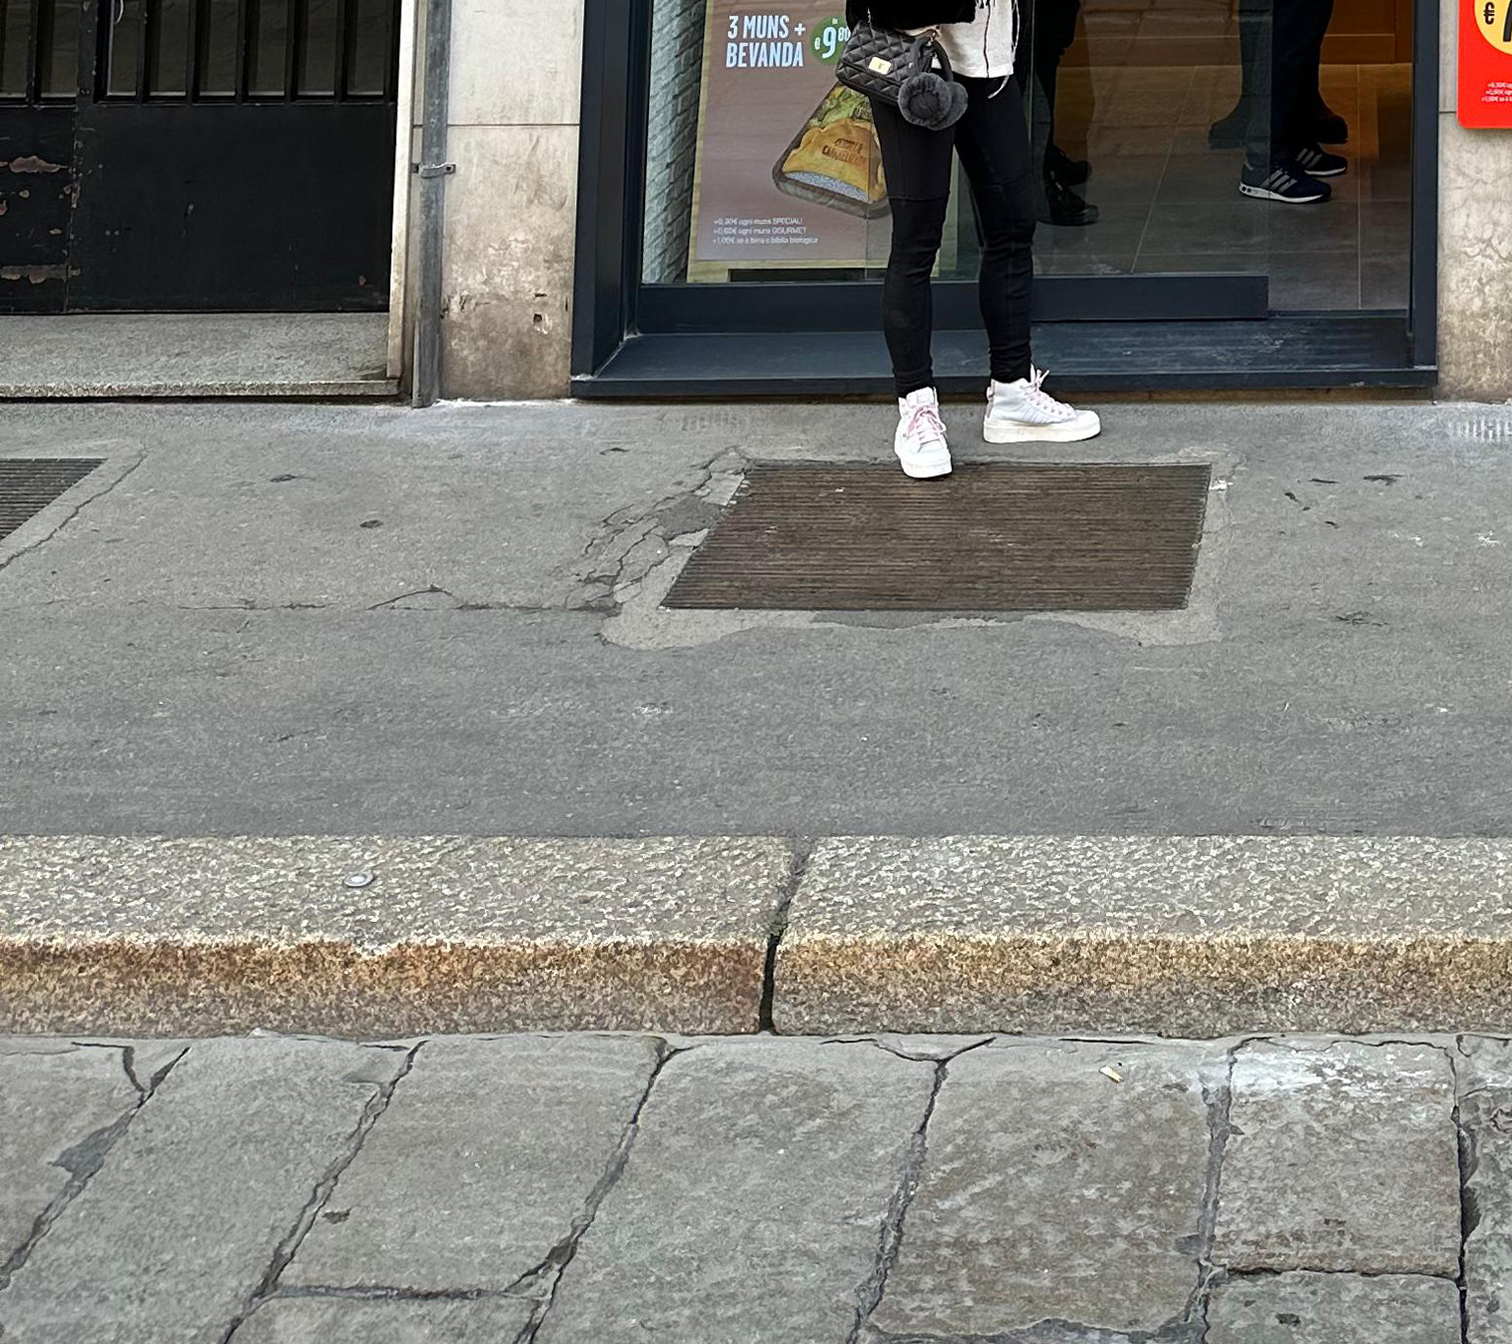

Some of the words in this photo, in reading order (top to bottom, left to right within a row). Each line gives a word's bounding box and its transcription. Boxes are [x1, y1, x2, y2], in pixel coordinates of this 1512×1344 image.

[727, 15, 739, 39] 3
[742, 15, 790, 39] MUNS
[725, 41, 804, 68] BEVANDA
